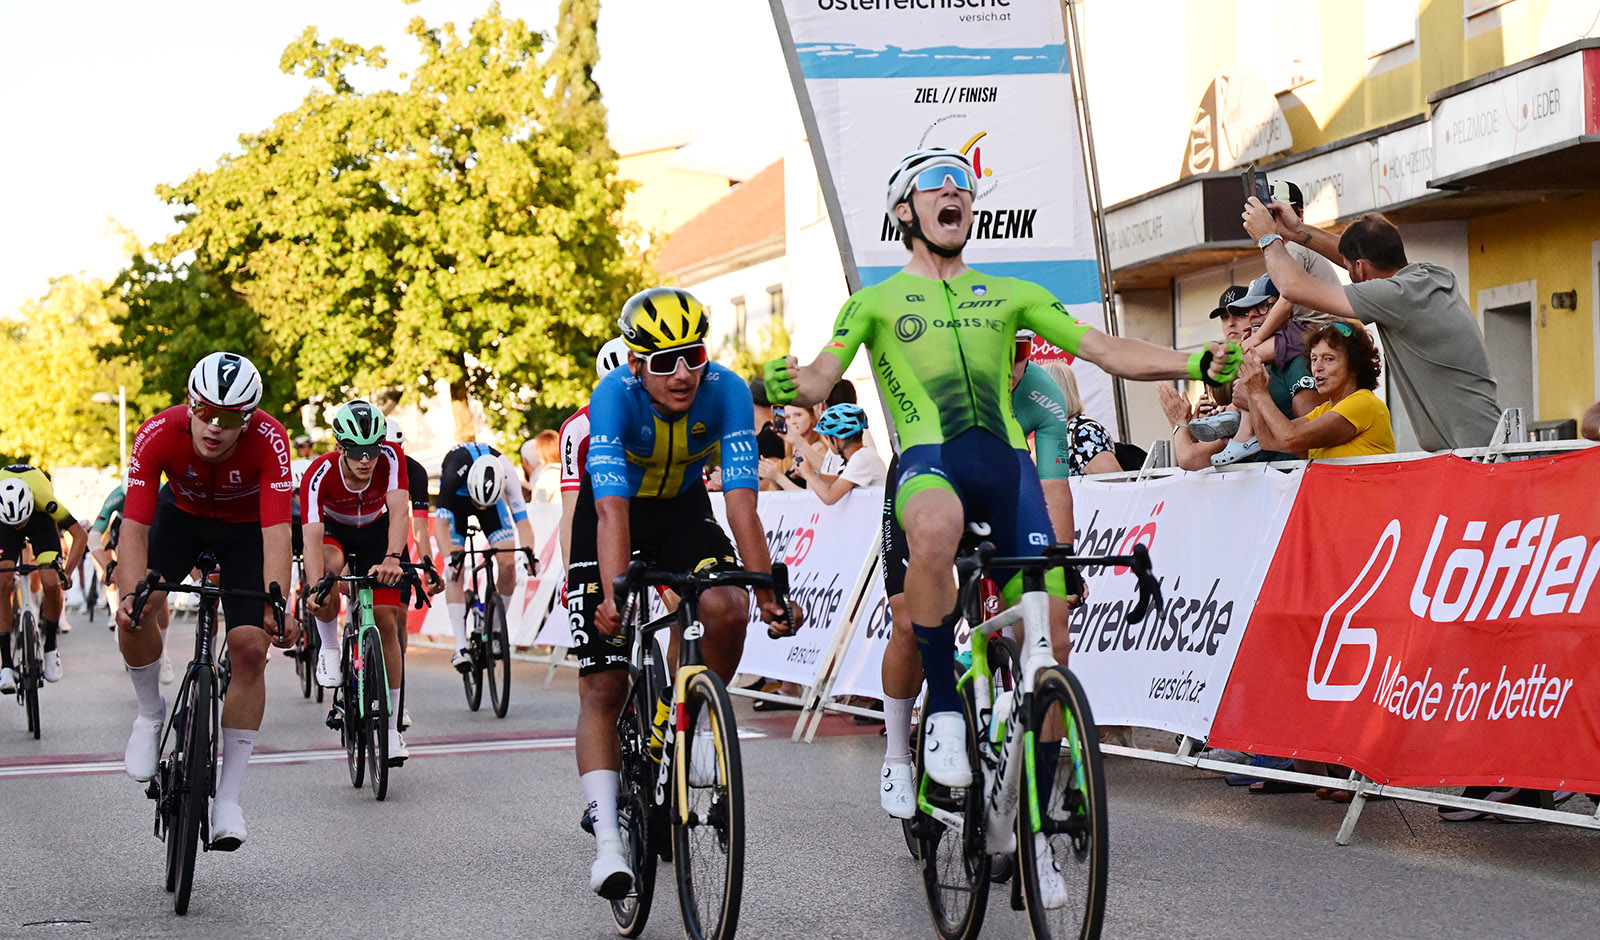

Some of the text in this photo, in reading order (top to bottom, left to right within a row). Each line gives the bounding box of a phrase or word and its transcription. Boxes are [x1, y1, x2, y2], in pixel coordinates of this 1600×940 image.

[959, 12, 1011, 22] versich.at
[914, 88, 938, 103] ZIEL
[959, 87, 997, 103] FINISH
[1532, 88, 1561, 121] LEDER
[1453, 109, 1498, 146] PELZMODE
[878, 352, 920, 424] SLOVENIA
[1028, 390, 1067, 422] SILVINI
[884, 519, 893, 551] ROMAN
[1409, 513, 1600, 622] löffler
[568, 583, 589, 648] JEGG
[1374, 655, 1573, 722] Made for better
